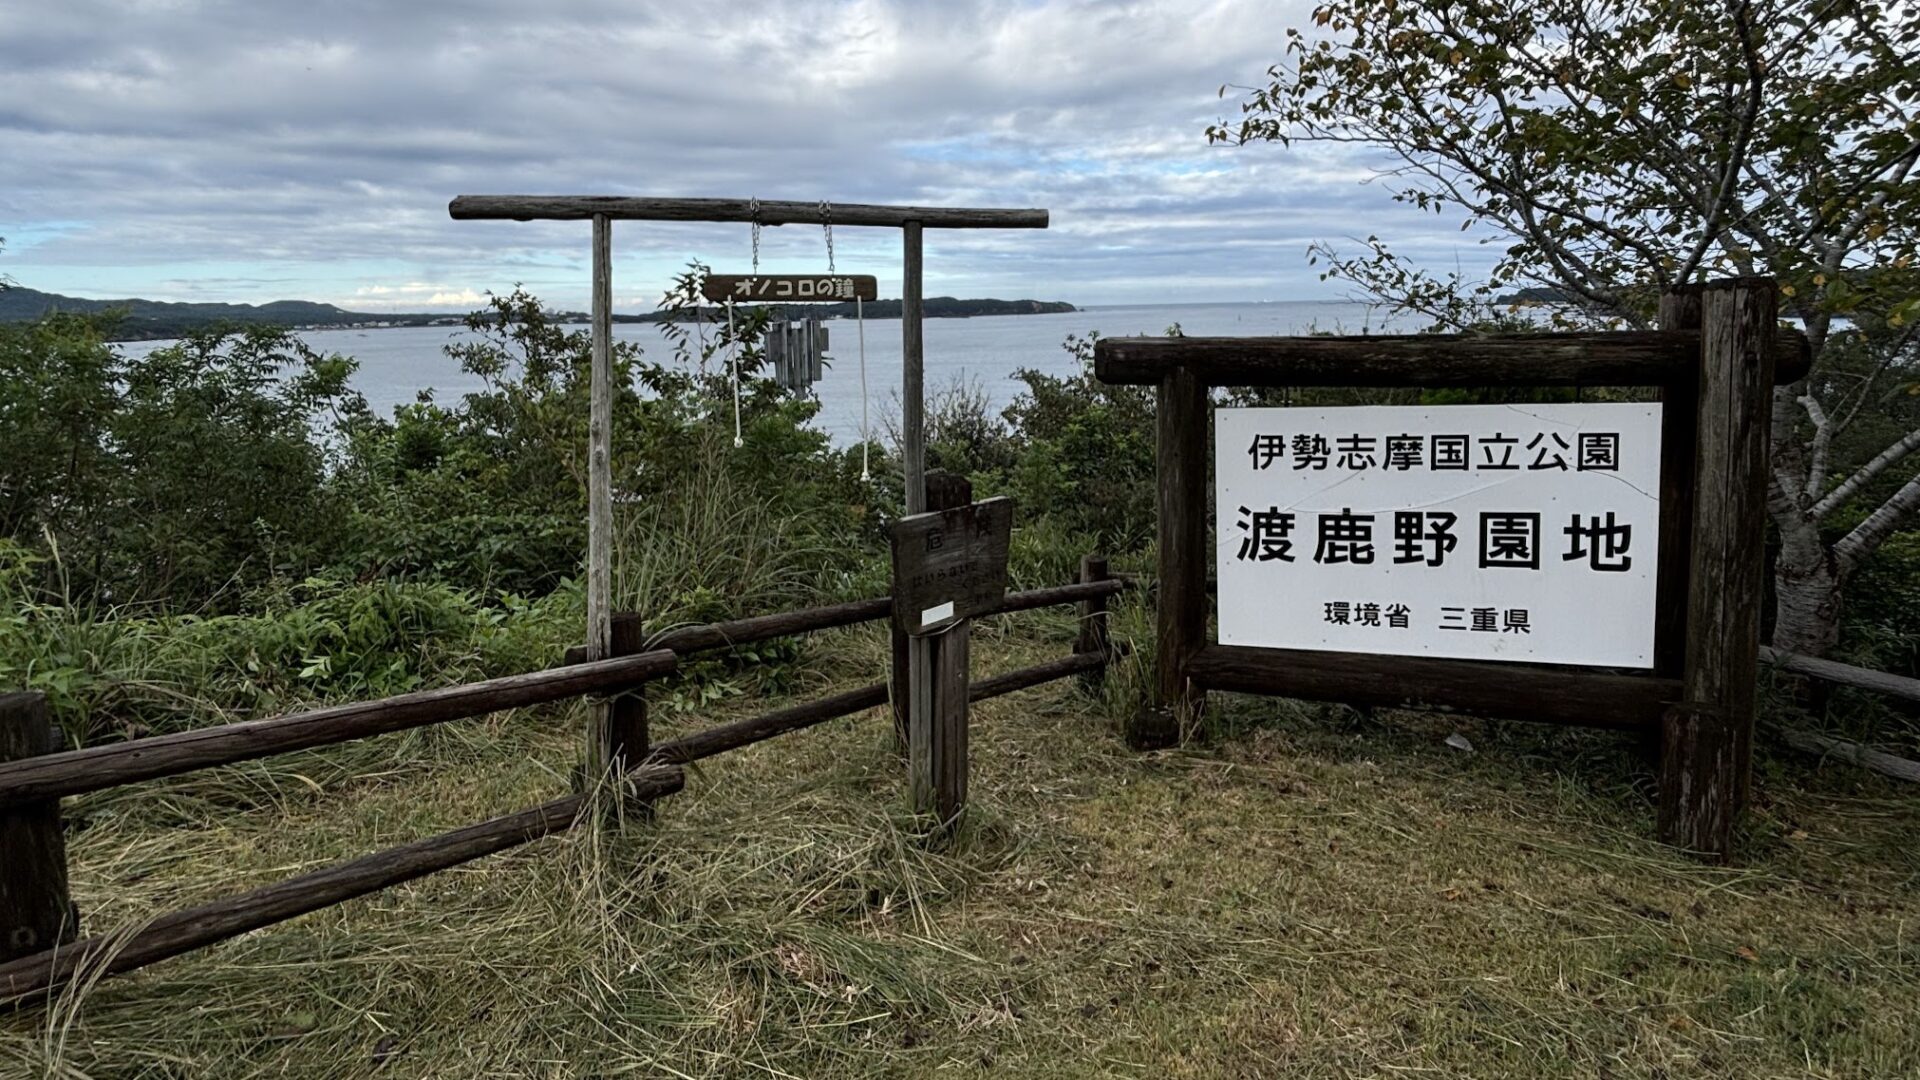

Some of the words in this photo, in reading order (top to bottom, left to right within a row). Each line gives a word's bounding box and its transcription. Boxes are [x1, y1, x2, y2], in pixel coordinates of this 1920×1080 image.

[735, 279, 855, 298] オノコロの鐘
[1248, 432, 1620, 472] 伊勢志摩国立公園
[1236, 505, 1632, 572] 渡鹿野園地
[1324, 602, 1411, 629] 環境省
[1438, 607, 1531, 634] 三重県
